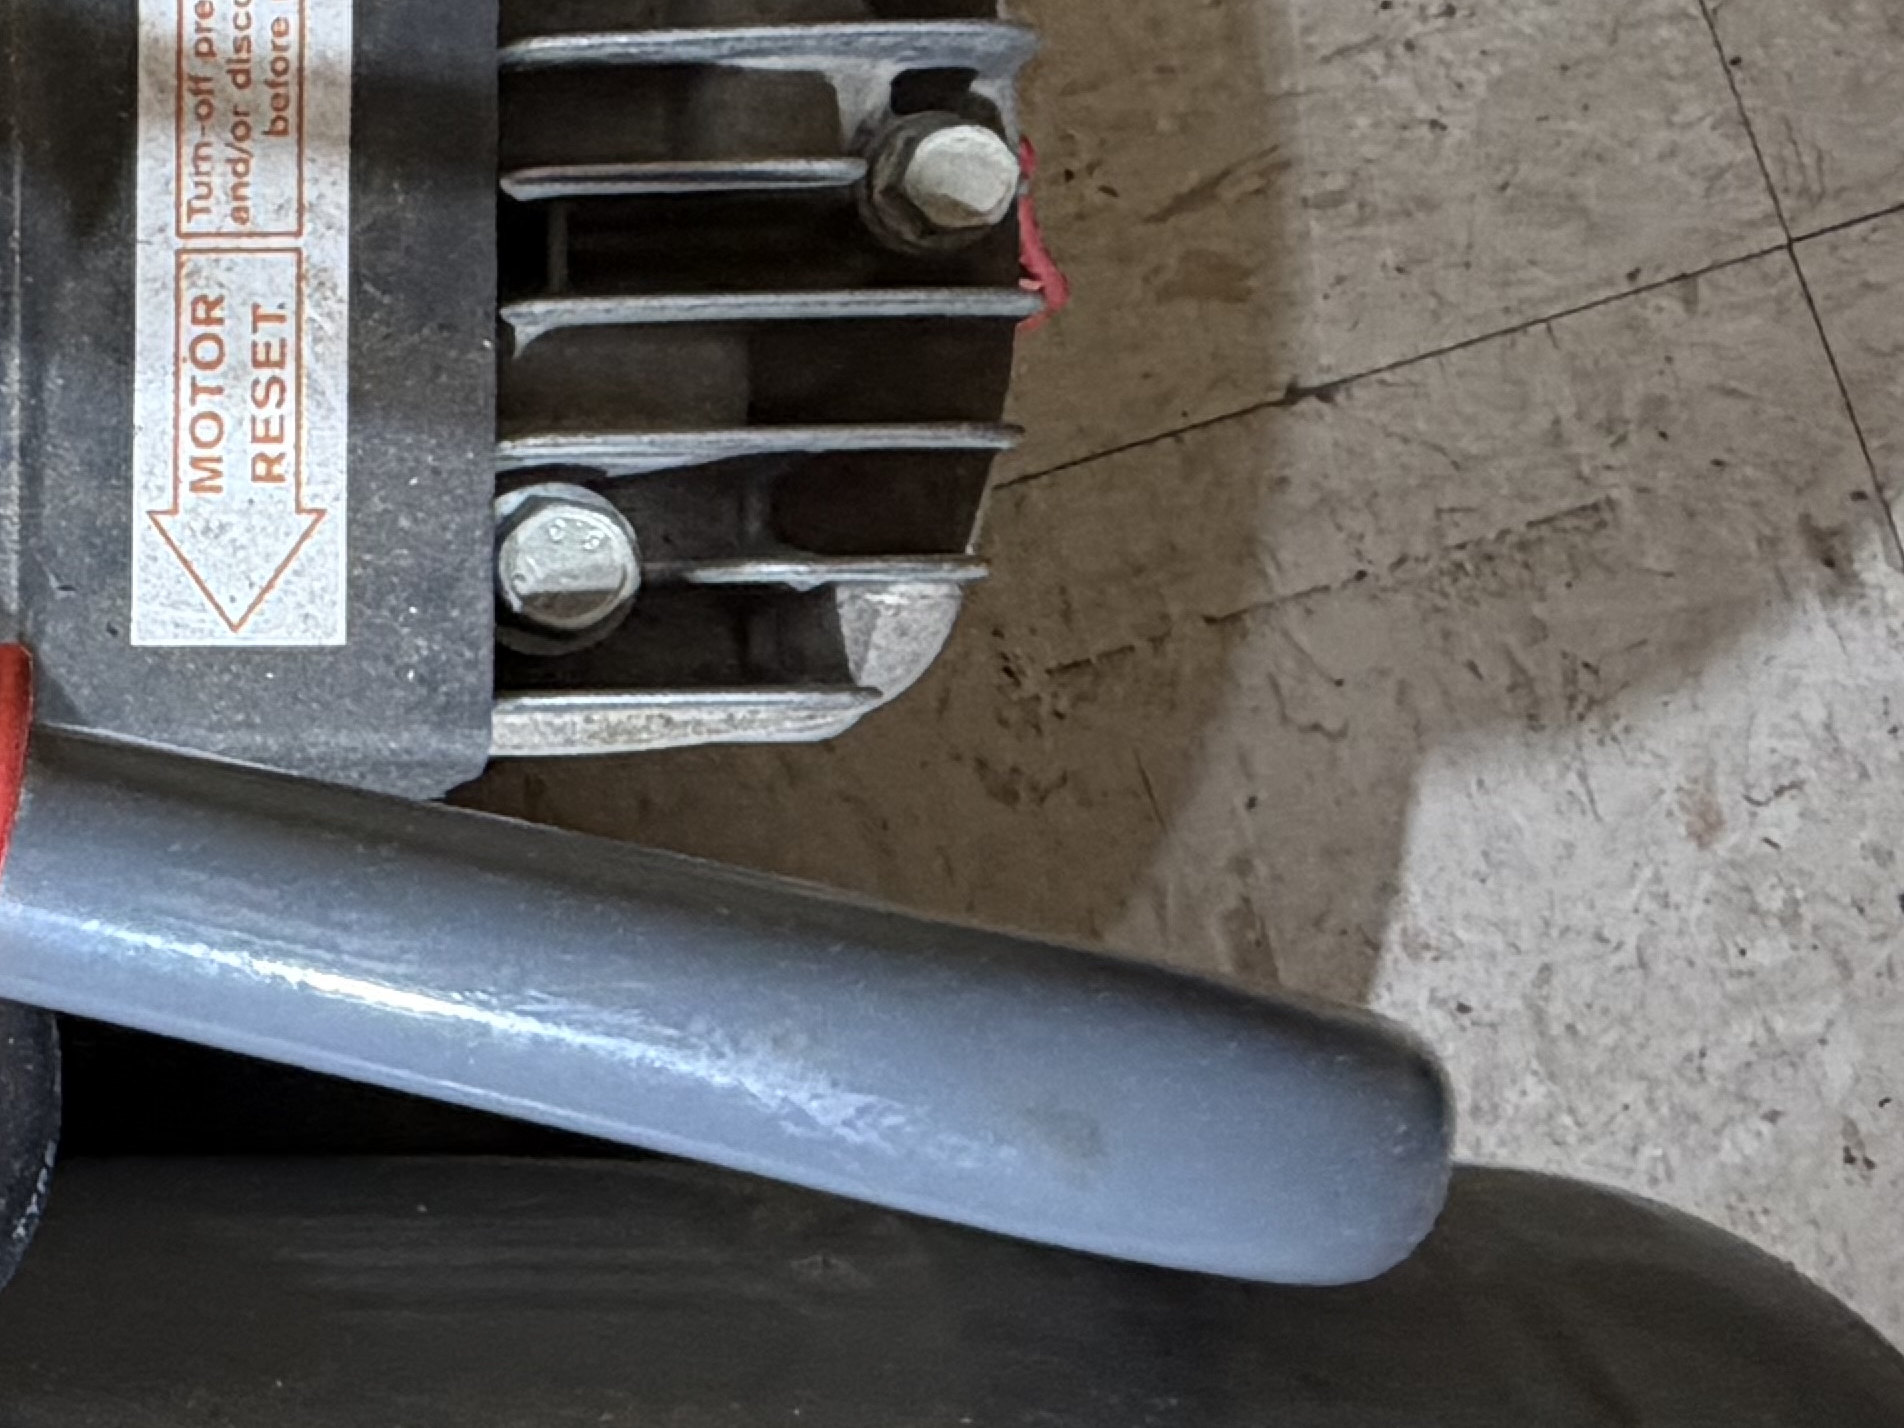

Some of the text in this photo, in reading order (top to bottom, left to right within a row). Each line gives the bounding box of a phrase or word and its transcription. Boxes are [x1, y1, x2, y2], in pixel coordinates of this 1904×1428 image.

[187, 73, 216, 224] Turn-off
[262, 17, 290, 137] before
[225, 106, 251, 226] and/or
[189, 294, 226, 494] MOTOR
[250, 302, 287, 483] RESET
